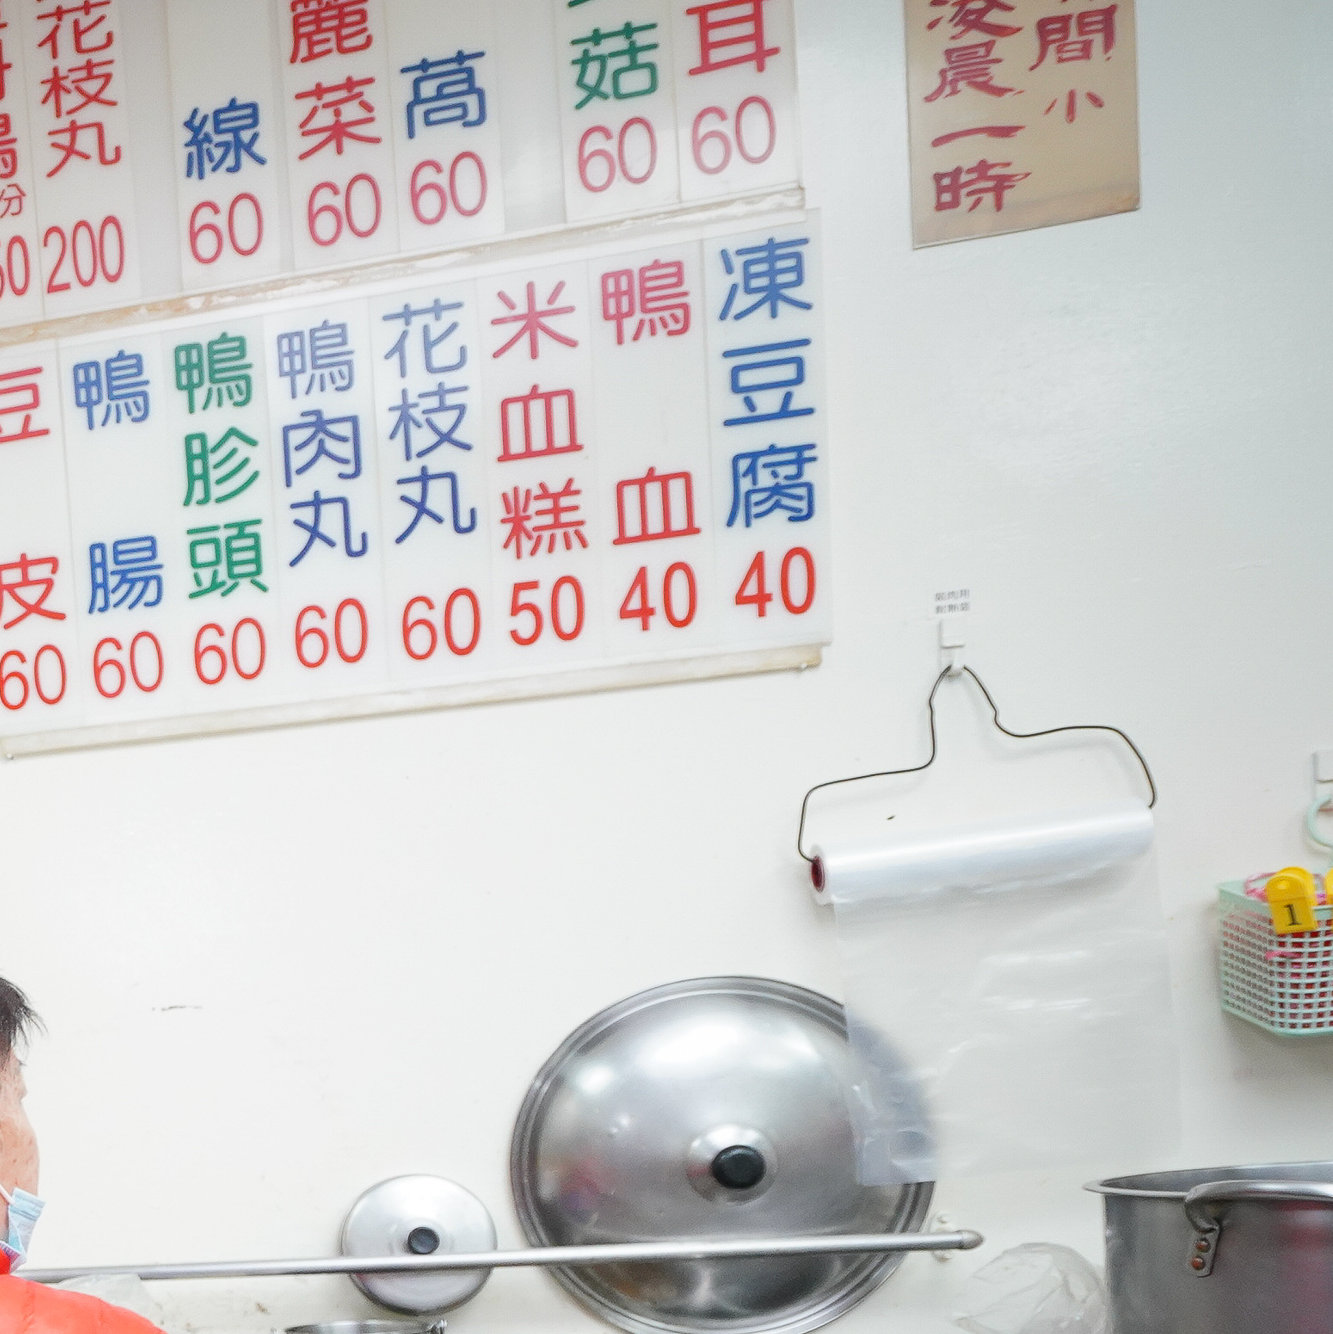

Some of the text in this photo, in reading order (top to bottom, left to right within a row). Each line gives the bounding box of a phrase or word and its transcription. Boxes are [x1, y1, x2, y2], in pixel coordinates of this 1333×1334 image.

[35, 0, 122, 178] 花枝丸
[568, 0, 658, 109] 菇
[184, 97, 267, 180] 線
[578, 117, 657, 193] 60
[692, 95, 776, 176] 60
[307, 173, 382, 247] 60
[410, 151, 487, 225] 60
[42, 215, 125, 294] 200
[188, 193, 263, 264] 60
[382, 298, 477, 544] 花枝丸
[491, 281, 588, 560] 米血糕
[601, 259, 701, 546] 鴨血
[718, 237, 818, 529] 凍豆腐
[174, 333, 268, 600] 鴨胗頭
[277, 320, 368, 566] 鴨肉丸
[73, 350, 164, 614] 鴨腸
[510, 575, 585, 646] 50
[618, 561, 698, 631] 40
[734, 546, 817, 618] 40
[193, 617, 266, 685] 60
[294, 598, 369, 669] 60
[401, 587, 481, 661] 60
[92, 631, 164, 699] 60
[1283, 904, 1302, 926] 1
